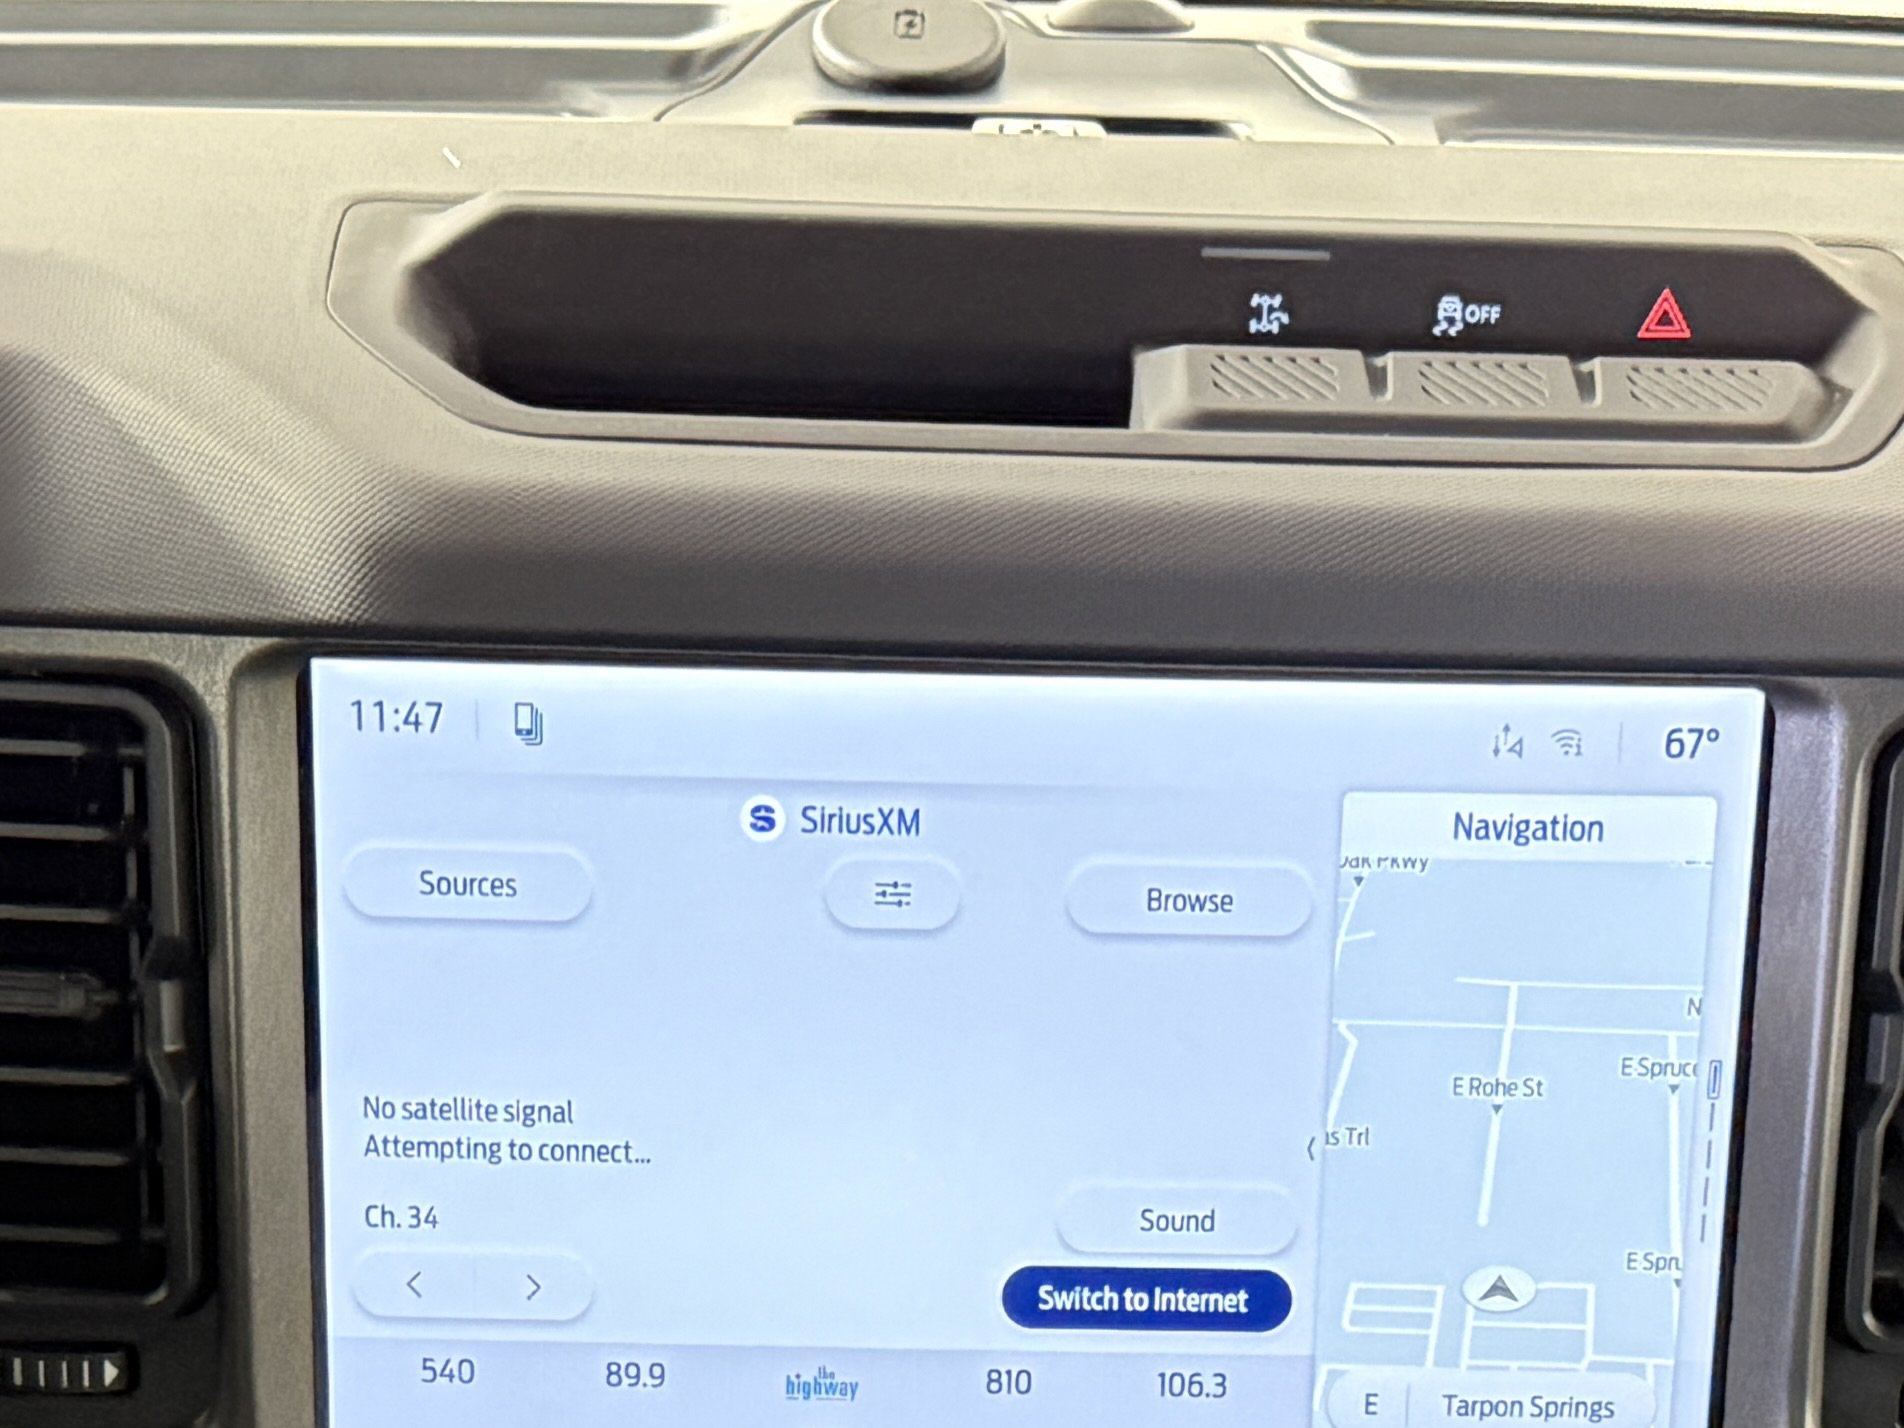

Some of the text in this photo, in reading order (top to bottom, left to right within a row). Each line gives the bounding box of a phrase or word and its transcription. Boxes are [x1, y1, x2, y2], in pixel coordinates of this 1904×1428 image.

[1464, 303, 1501, 324] OFF
[349, 699, 444, 736] 11:47
[1663, 726, 1720, 760] 67°
[800, 805, 921, 838] SiriusXM
[1453, 812, 1604, 846] Navigation
[418, 869, 518, 899] Sources
[1146, 887, 1234, 915] Browse
[1621, 1057, 1634, 1077] E
[1453, 1077, 1464, 1097] E
[1522, 1078, 1544, 1098] St
[362, 1095, 574, 1127] No satellite signal
[364, 1134, 652, 1164] Attempting to connect...
[1345, 1126, 1369, 1145] Trl
[364, 1204, 440, 1230] Ch. 34
[1140, 1209, 1215, 1234] Sound
[1627, 1252, 1638, 1270] E
[1038, 1285, 1248, 1314] Switch to Internet
[421, 1358, 475, 1384] 540
[605, 1362, 666, 1388] 89.9
[986, 1369, 1032, 1396] 810
[785, 1374, 859, 1402] highway
[1157, 1372, 1227, 1399] 106.3
[1364, 1394, 1378, 1416] E
[1443, 1395, 1615, 1425] Tarpon Springs
